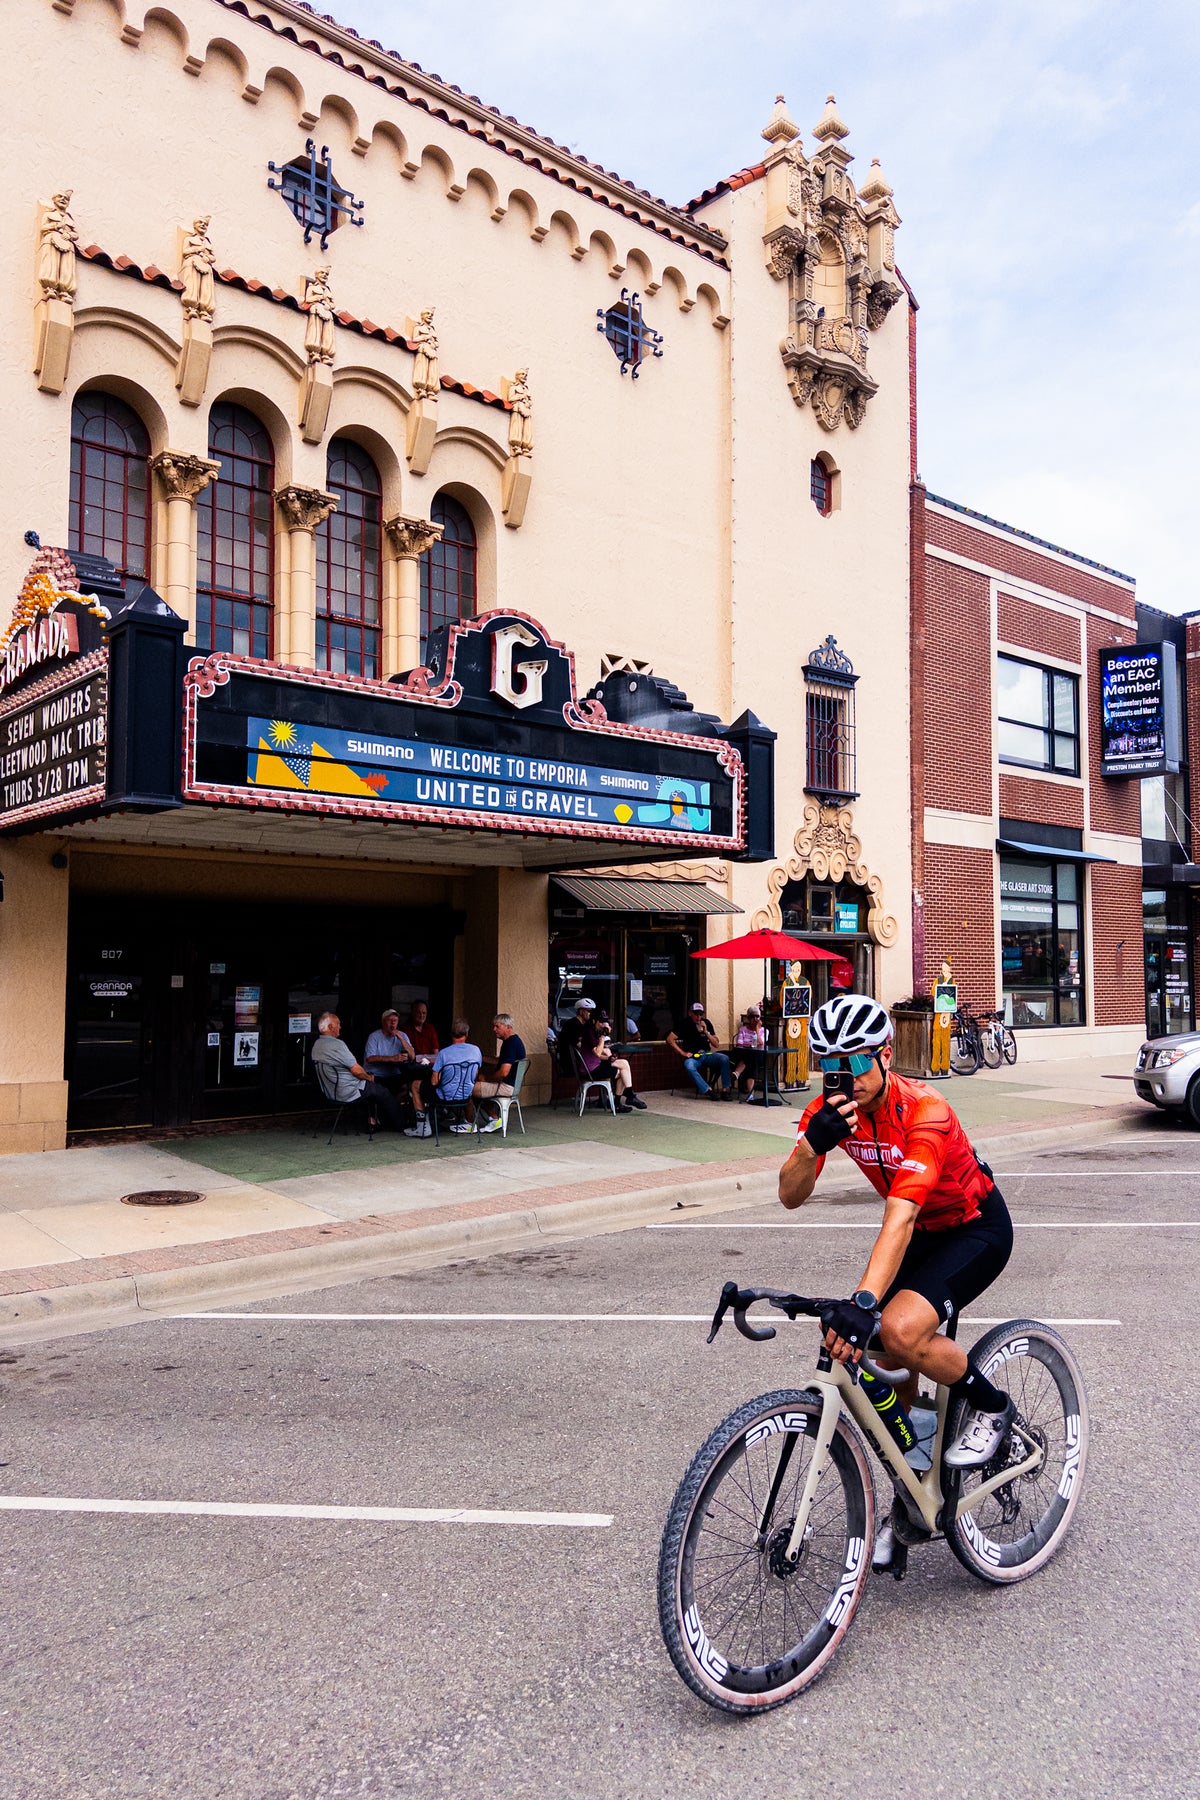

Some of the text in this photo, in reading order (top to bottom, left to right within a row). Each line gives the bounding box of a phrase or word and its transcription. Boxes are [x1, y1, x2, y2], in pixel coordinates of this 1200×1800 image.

[490, 622, 549, 708] G
[1107, 657, 1158, 671] Become
[1110, 668, 1155, 683] an EAC
[1105, 680, 1161, 696] Member!
[1142, 697, 1160, 705] Tickets
[7, 684, 91, 746] SEVEN WONDERS
[1134, 707, 1142, 716] and
[0, 716, 105, 779] LEETWOOD MAC TRIB
[347, 739, 414, 760] SHIMANO
[430, 747, 588, 786] WELCOME TO EMPORIA
[1107, 761, 1160, 771] PRESTON FAMILY TRUST
[4, 757, 89, 807] THURS 5/28 7PM
[600, 775, 649, 791] SHIMANO
[416, 777, 598, 817] UNITED IN GRAVEL
[1008, 881, 1027, 892] GLASER
[1028, 883, 1037, 893] ART
[1038, 884, 1053, 894] STORE
[839, 911, 857, 920] WELCOME
[101, 950, 123, 959] 807
[90, 982, 133, 991] GRANADA
